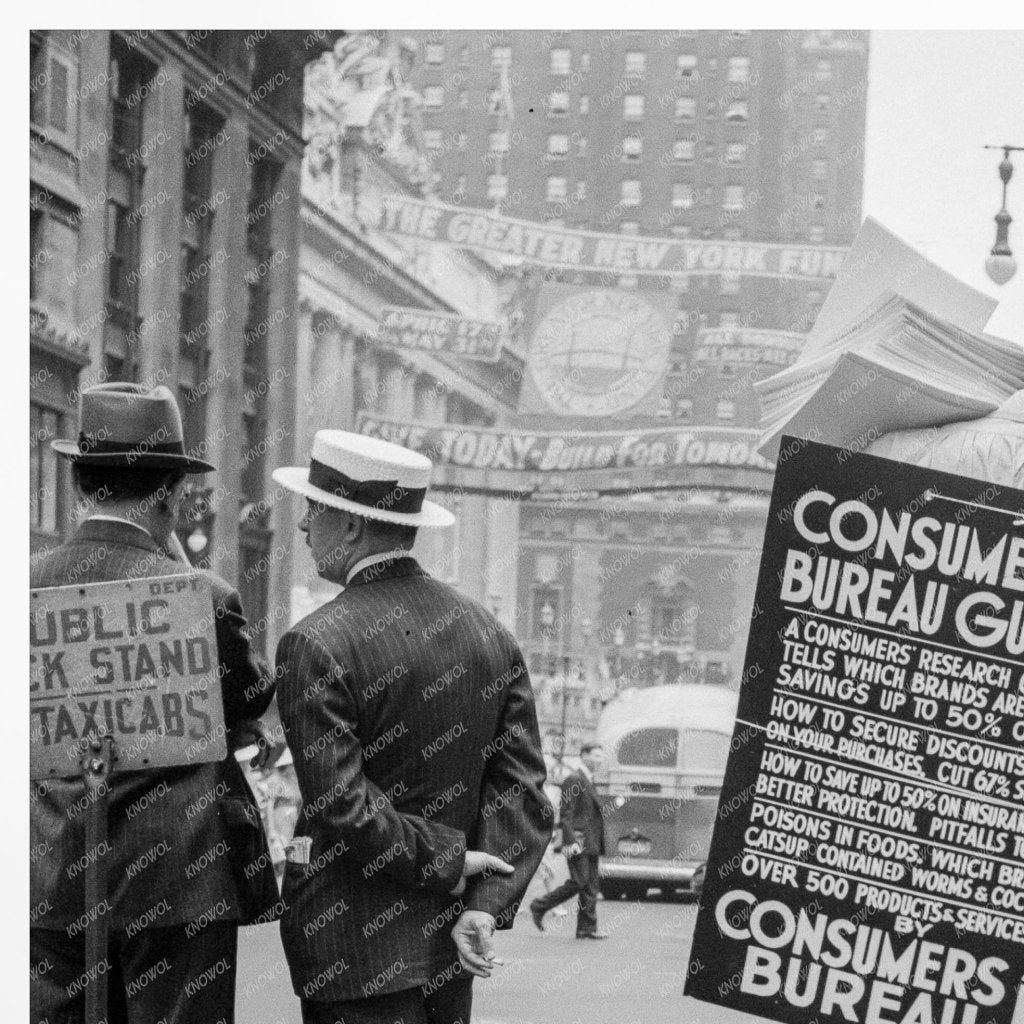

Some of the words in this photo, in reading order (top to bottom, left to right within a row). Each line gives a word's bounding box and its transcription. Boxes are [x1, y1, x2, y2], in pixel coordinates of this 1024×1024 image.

[383, 202, 443, 238] THE
[447, 214, 584, 264] GREATER
[593, 241, 669, 270] NEW
[684, 247, 770, 271] YORK
[780, 549, 949, 635] BUREAU
[90, 637, 212, 685] STAND
[783, 639, 836, 671] TELLS
[844, 654, 906, 690] WHICH
[910, 672, 990, 709] BRANDS
[784, 617, 799, 639] A
[918, 648, 1012, 689] RESEARCH
[31, 690, 212, 746] TAXICABS
[770, 695, 818, 725] HOW
[822, 708, 845, 732] TO
[849, 715, 920, 751] SECURE
[776, 664, 870, 705] SAVINGS
[880, 689, 906, 713] UP
[913, 696, 938, 721] TO
[945, 705, 1002, 737] 50%
[760, 750, 802, 778] HOW
[803, 760, 823, 784] TO
[822, 765, 860, 794] SAVE
[860, 776, 882, 798] UP
[882, 780, 901, 804] TO
[900, 785, 938, 812] 50%
[937, 793, 962, 819] ON
[789, 726, 835, 754] YOUR
[835, 736, 927, 779] PURCHASES.
[937, 761, 974, 788] CUT
[973, 769, 1010, 798] 67%
[750, 802, 832, 841] POISONS
[856, 830, 923, 865] FOODS.
[931, 847, 994, 881] WHICH
[755, 773, 814, 806] BETTER
[817, 788, 918, 833] PROTECTION.
[929, 816, 1009, 853] PITFALLS
[741, 854, 799, 888] OVER
[805, 870, 849, 900] 500
[744, 826, 810, 857] CATSUP
[816, 843, 905, 882] CONTAINED
[912, 866, 974, 899] WORMS
[715, 889, 1009, 1006] CONSUMERS
[894, 915, 934, 938] BY
